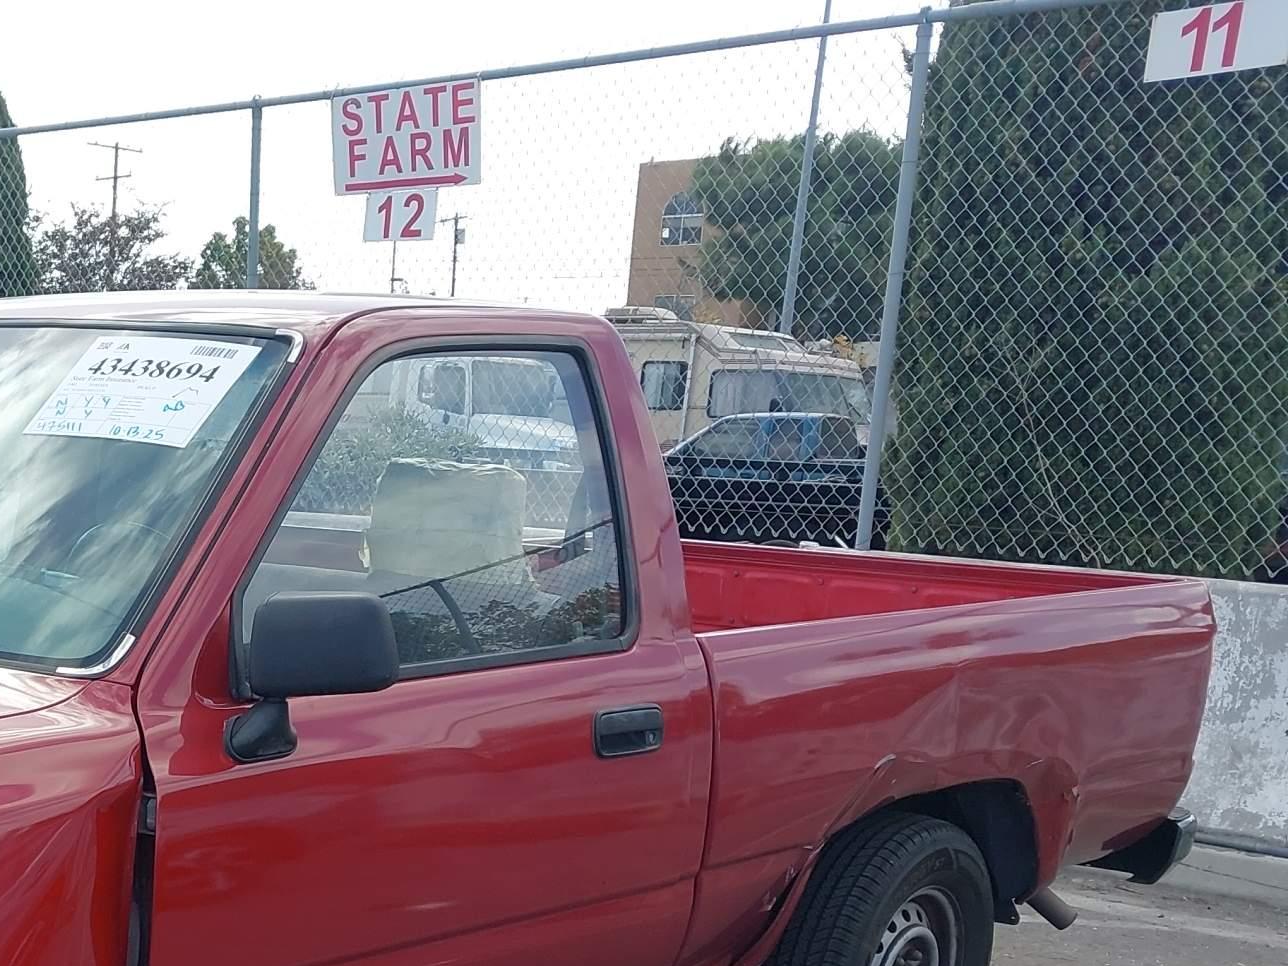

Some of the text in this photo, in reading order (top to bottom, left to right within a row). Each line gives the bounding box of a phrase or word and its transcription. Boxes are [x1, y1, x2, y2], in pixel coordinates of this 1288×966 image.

[1182, 1, 1245, 73] 11
[341, 82, 476, 138] STATE
[348, 126, 470, 178] FARM
[378, 193, 425, 239] 12
[88, 357, 222, 383] 43438694
